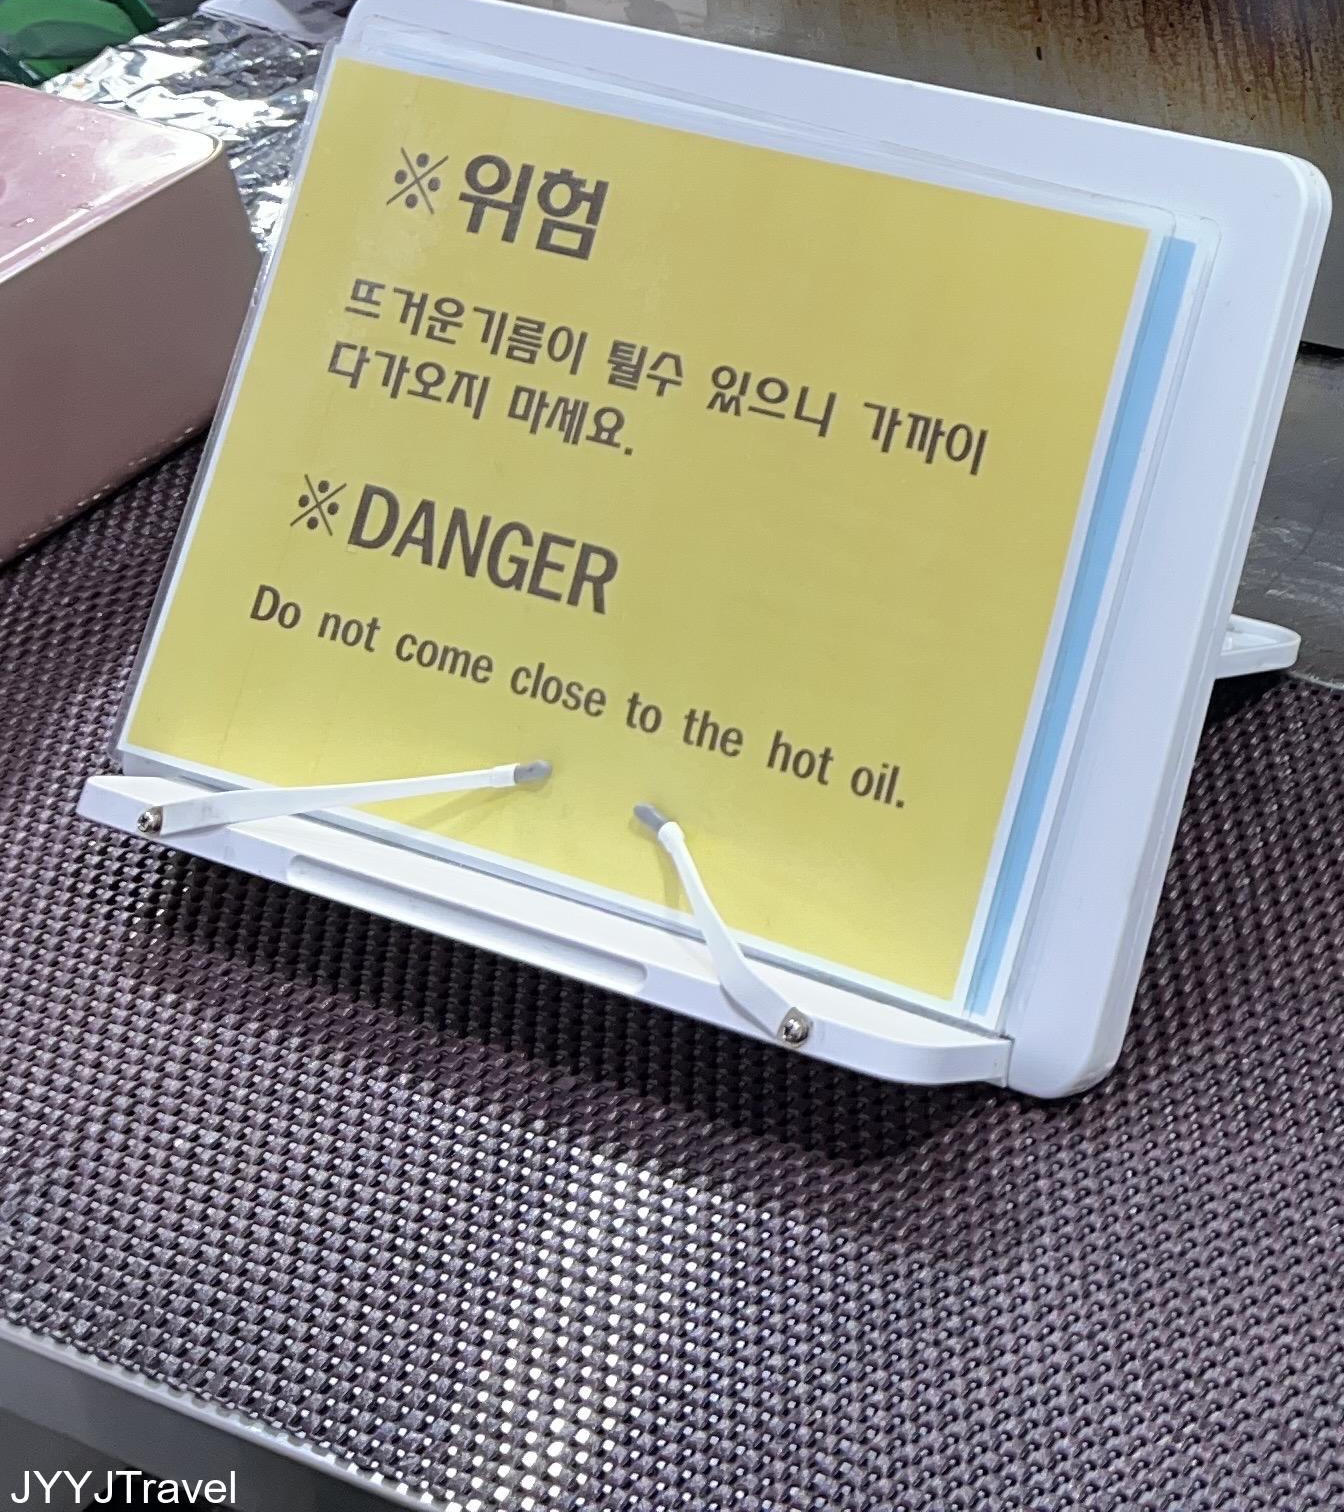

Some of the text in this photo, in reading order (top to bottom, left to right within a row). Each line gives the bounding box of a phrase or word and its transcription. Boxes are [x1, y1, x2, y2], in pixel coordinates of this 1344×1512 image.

[329, 339, 633, 457] 다가오지 마세요.
[606, 338, 684, 398] 튈수
[706, 364, 837, 439] 있으니
[863, 401, 989, 477] 가까이
[249, 583, 906, 810] Do not come close to the hot oil.
